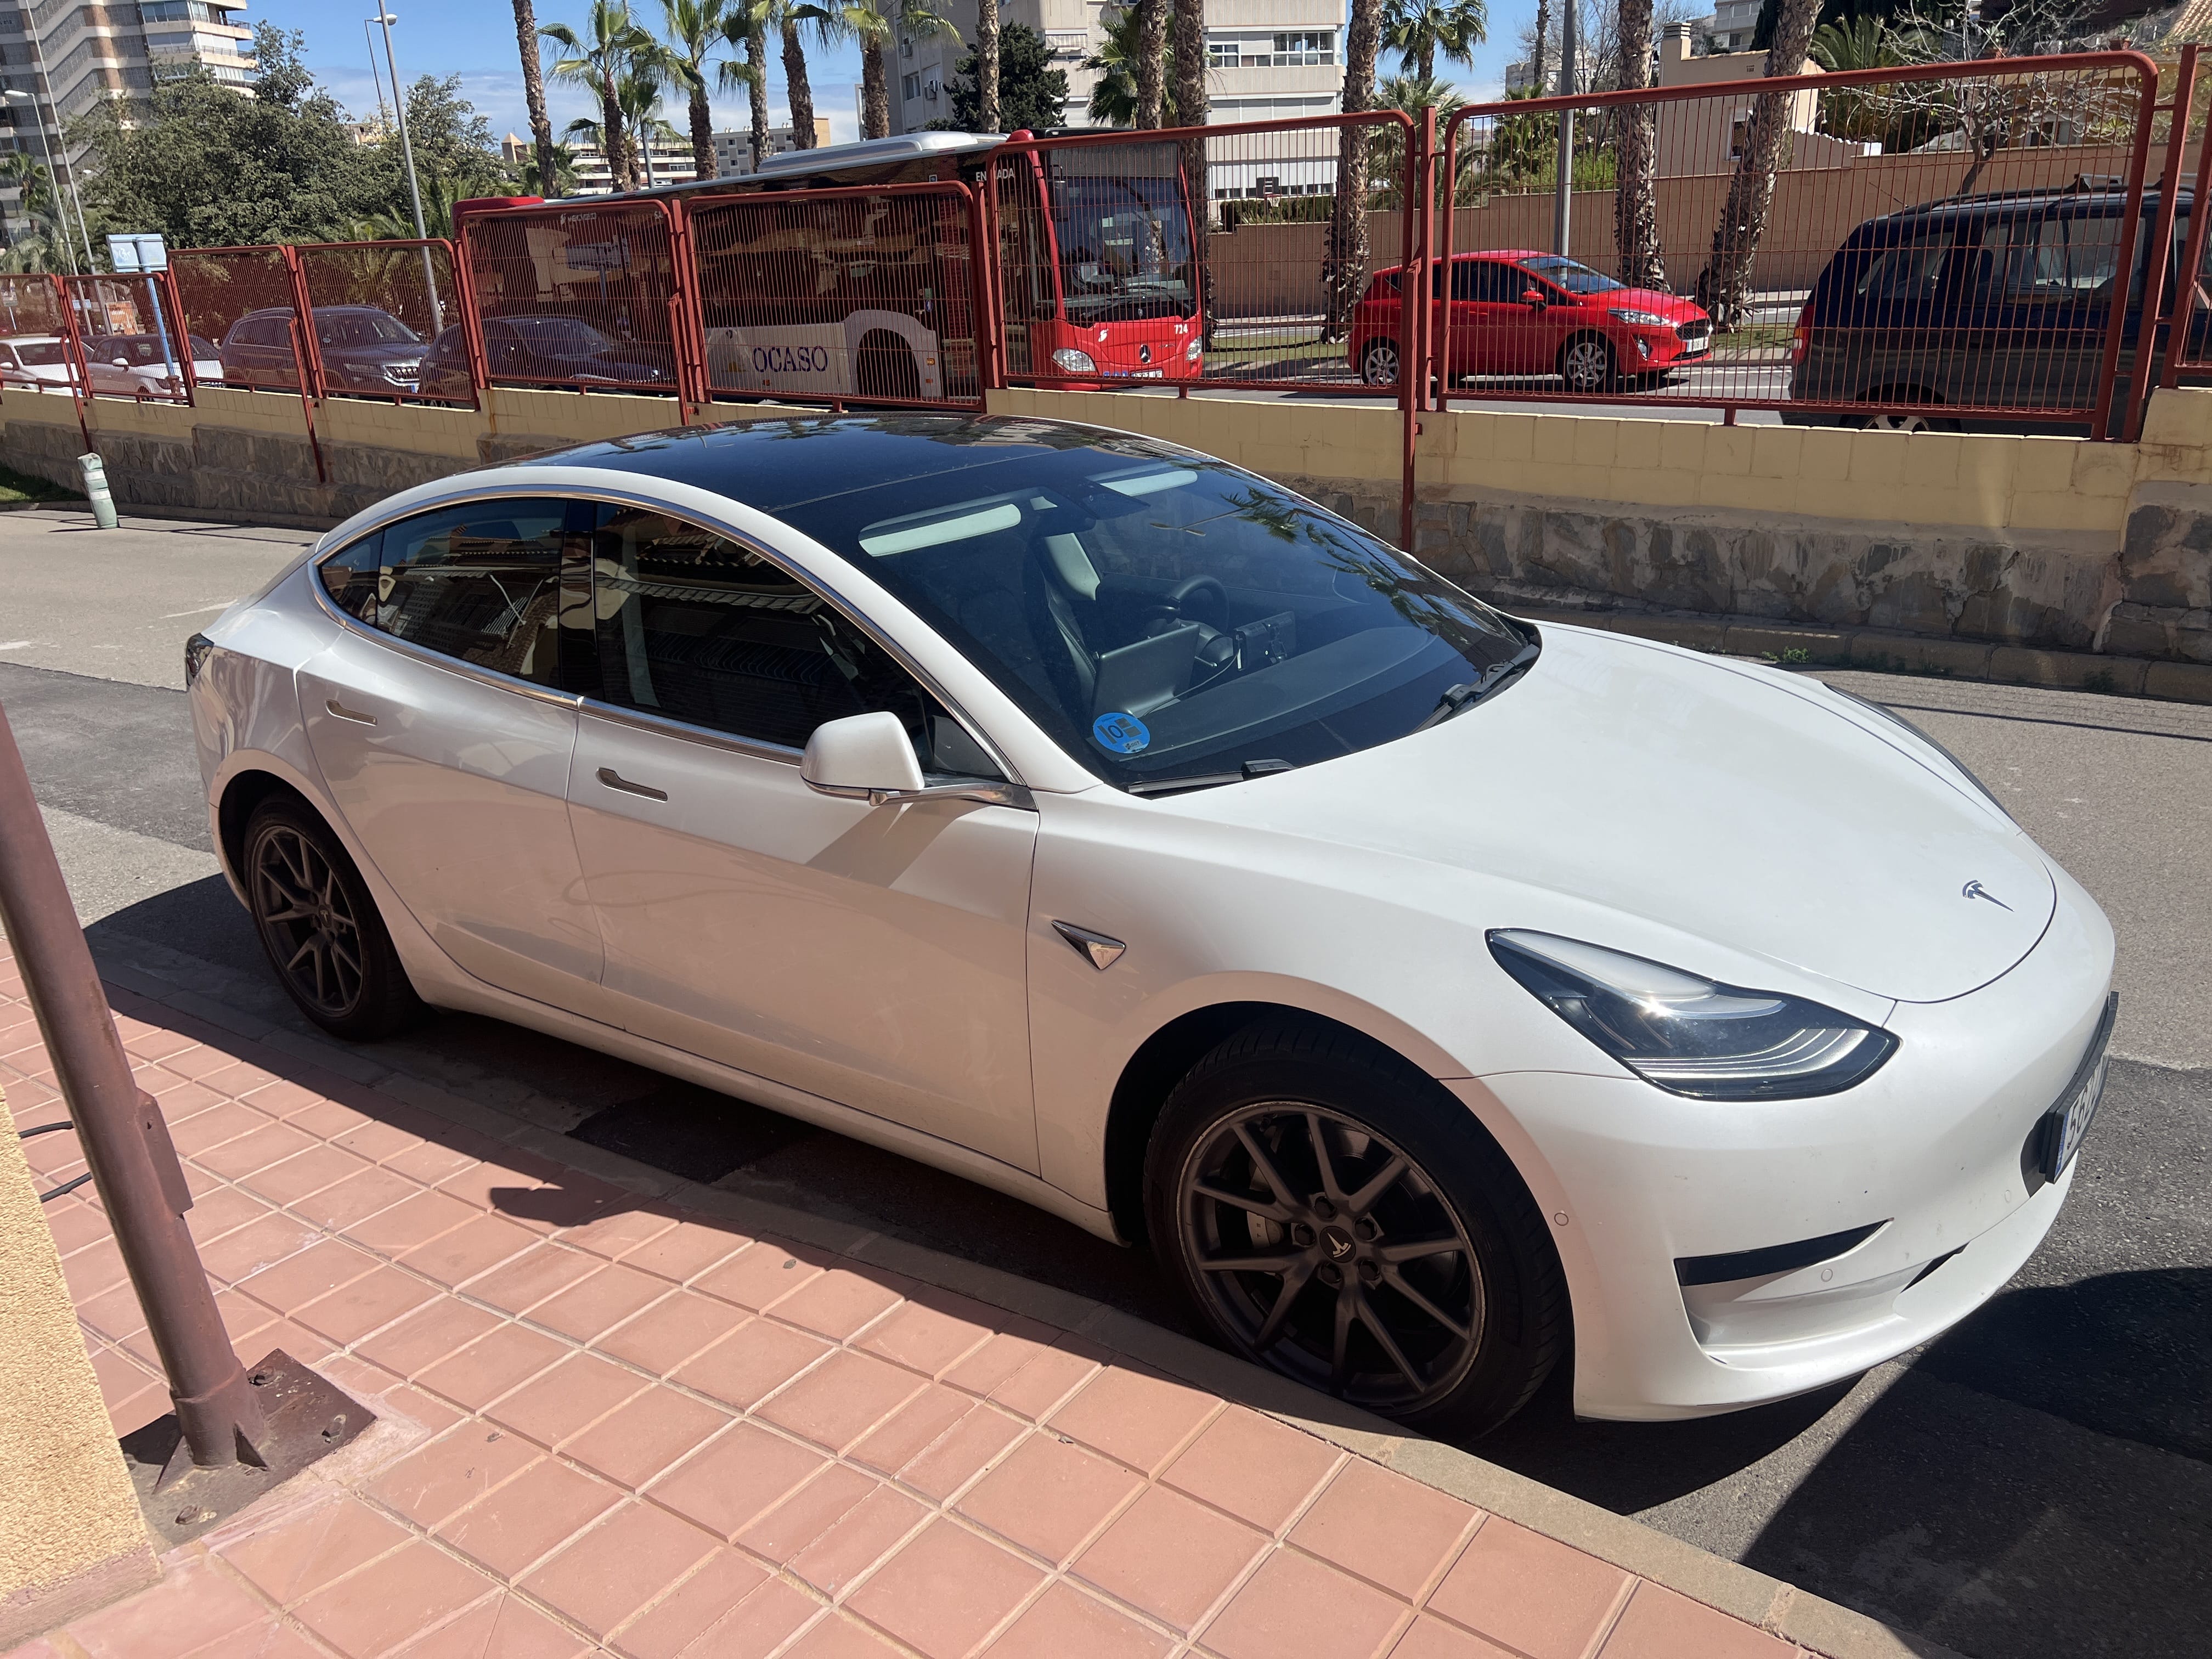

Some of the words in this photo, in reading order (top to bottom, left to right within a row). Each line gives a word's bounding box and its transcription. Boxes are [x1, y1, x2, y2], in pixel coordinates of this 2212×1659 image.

[976, 168, 1015, 182] ENADA
[1173, 323, 1188, 334] 724
[753, 346, 828, 373] OCASO
